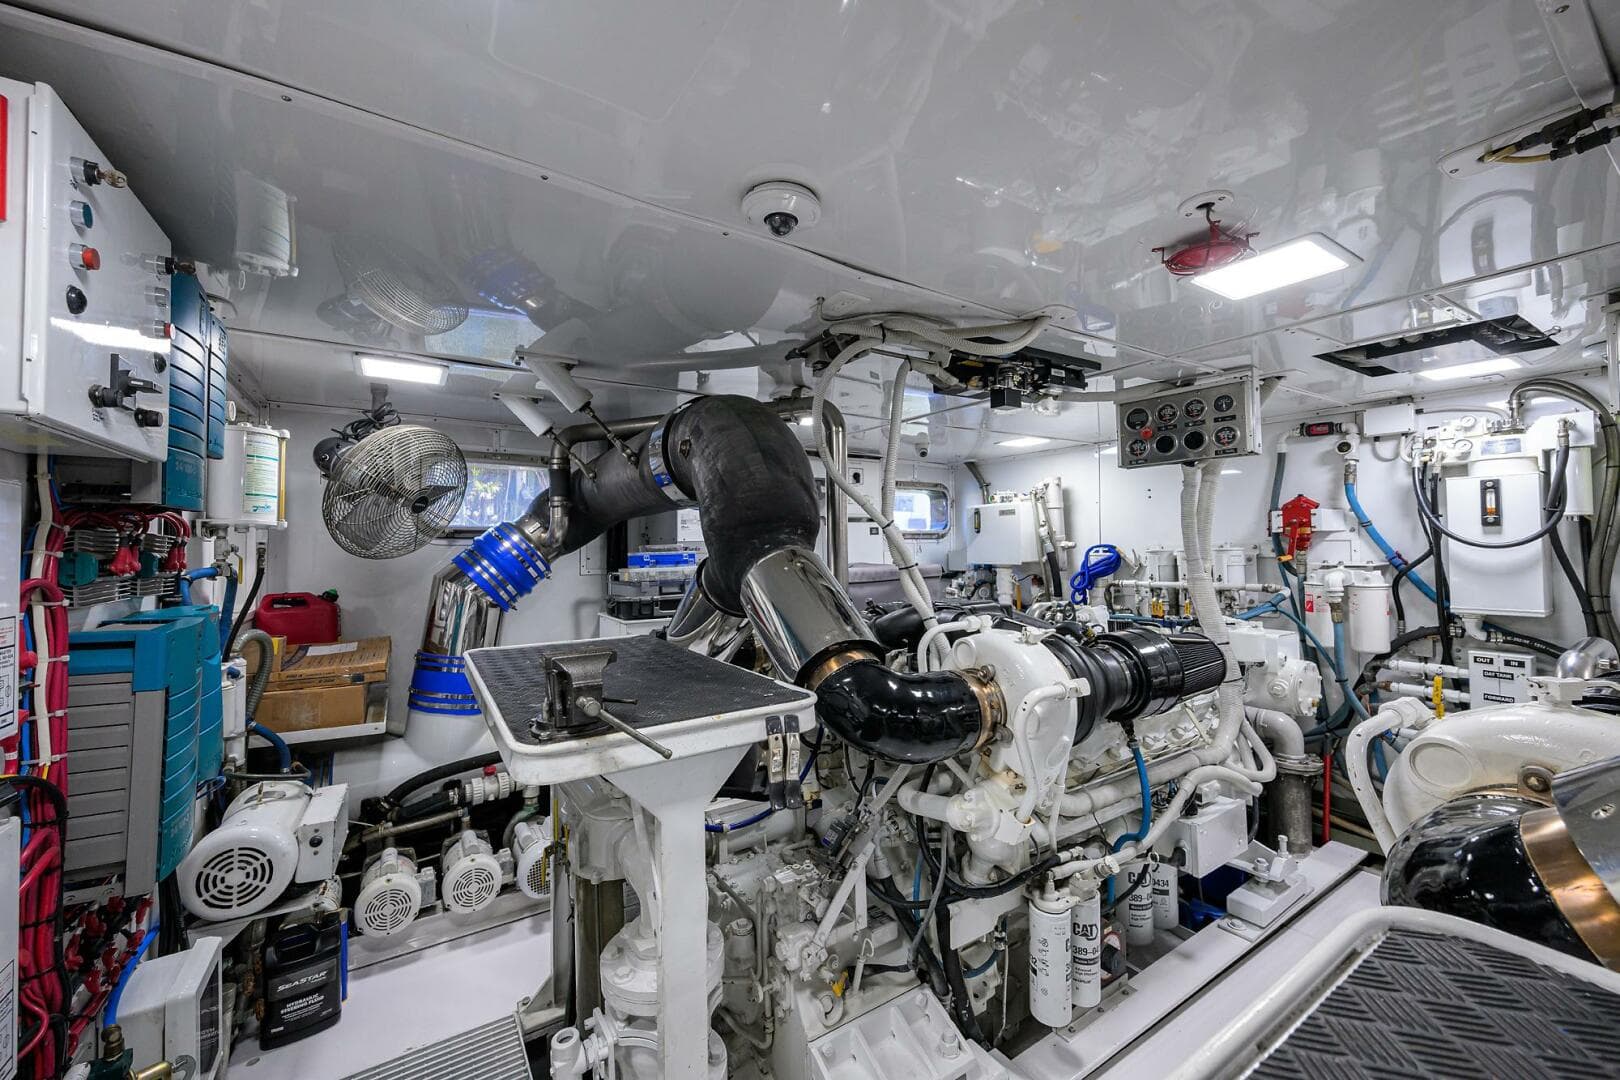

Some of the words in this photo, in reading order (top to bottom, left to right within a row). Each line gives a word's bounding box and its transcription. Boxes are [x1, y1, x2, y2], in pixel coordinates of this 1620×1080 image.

[1484, 694, 1514, 702] FORWARD
[1073, 922, 1099, 941] CAT
[277, 970, 328, 992] SEASTAR
[281, 1001, 308, 1014] STEERING
[308, 995, 325, 1005] FLUID
[286, 993, 319, 1008] HYDRAULIC
